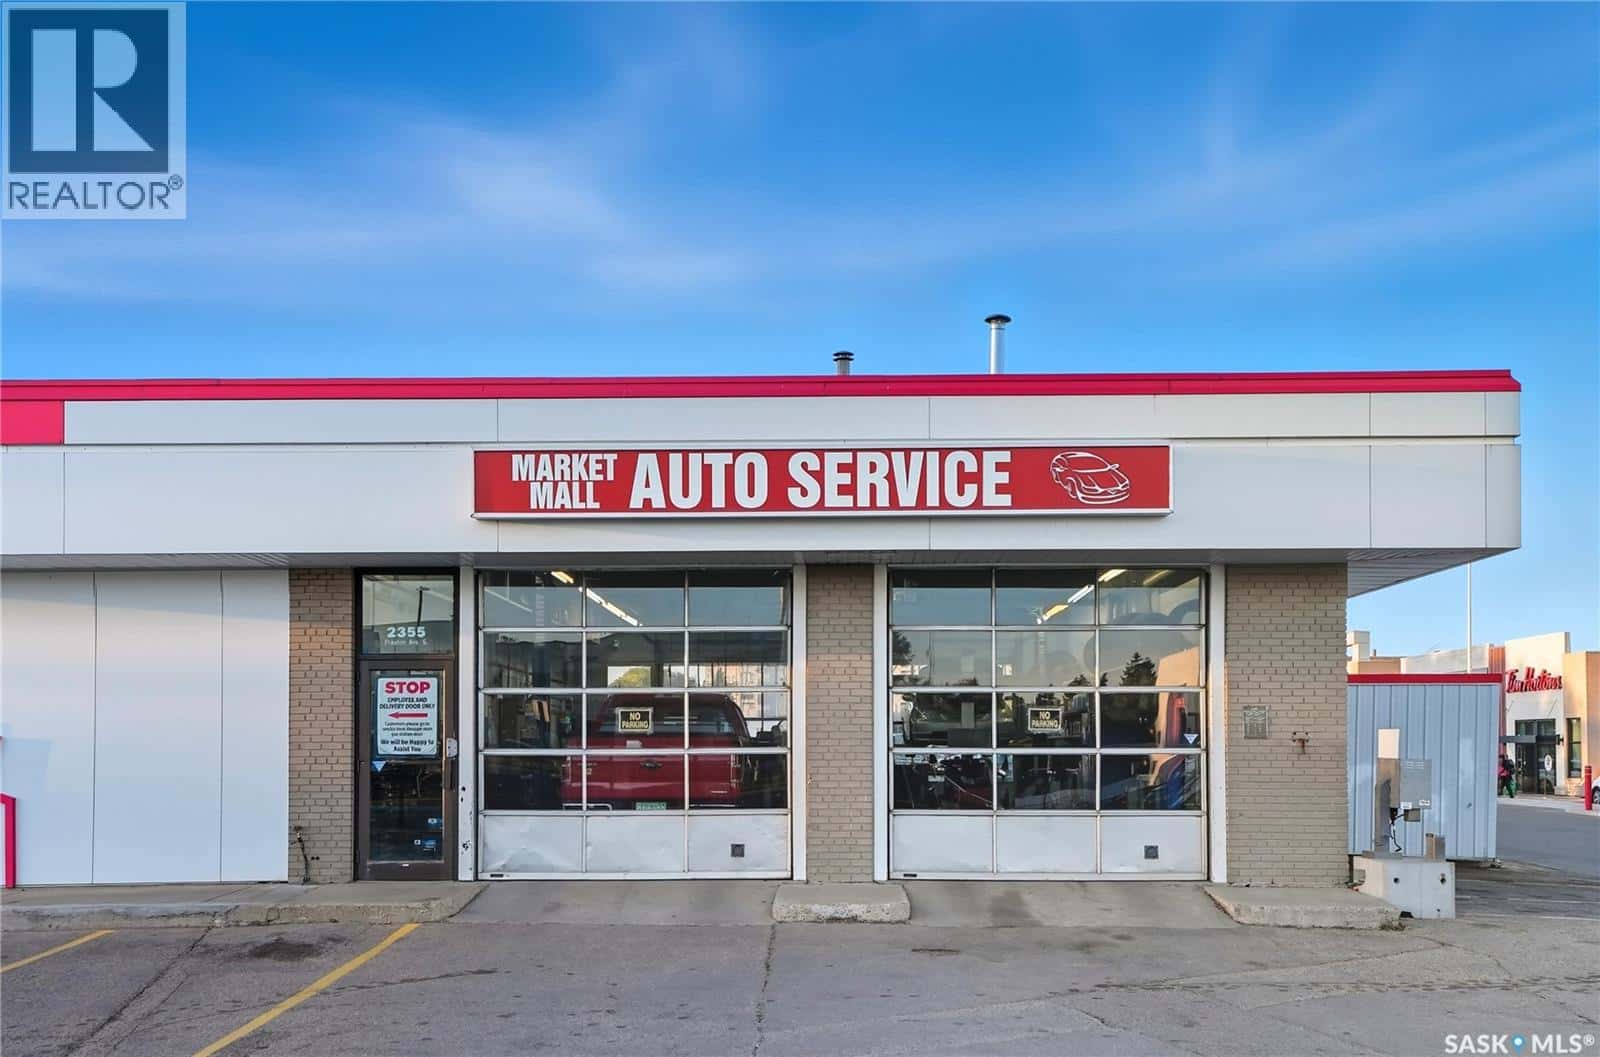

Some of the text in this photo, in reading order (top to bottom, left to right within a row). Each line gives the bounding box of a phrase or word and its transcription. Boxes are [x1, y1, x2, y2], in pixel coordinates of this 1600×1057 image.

[511, 453, 618, 482] MARKET
[629, 450, 1012, 509] AUTO SERVICE
[529, 481, 601, 510] MALL
[386, 626, 426, 638] 2355
[385, 681, 431, 694] STOP
[630, 711, 641, 721] NO
[1039, 711, 1051, 720] NO
[621, 720, 649, 729] PARKING
[1031, 719, 1059, 728] PARKING
